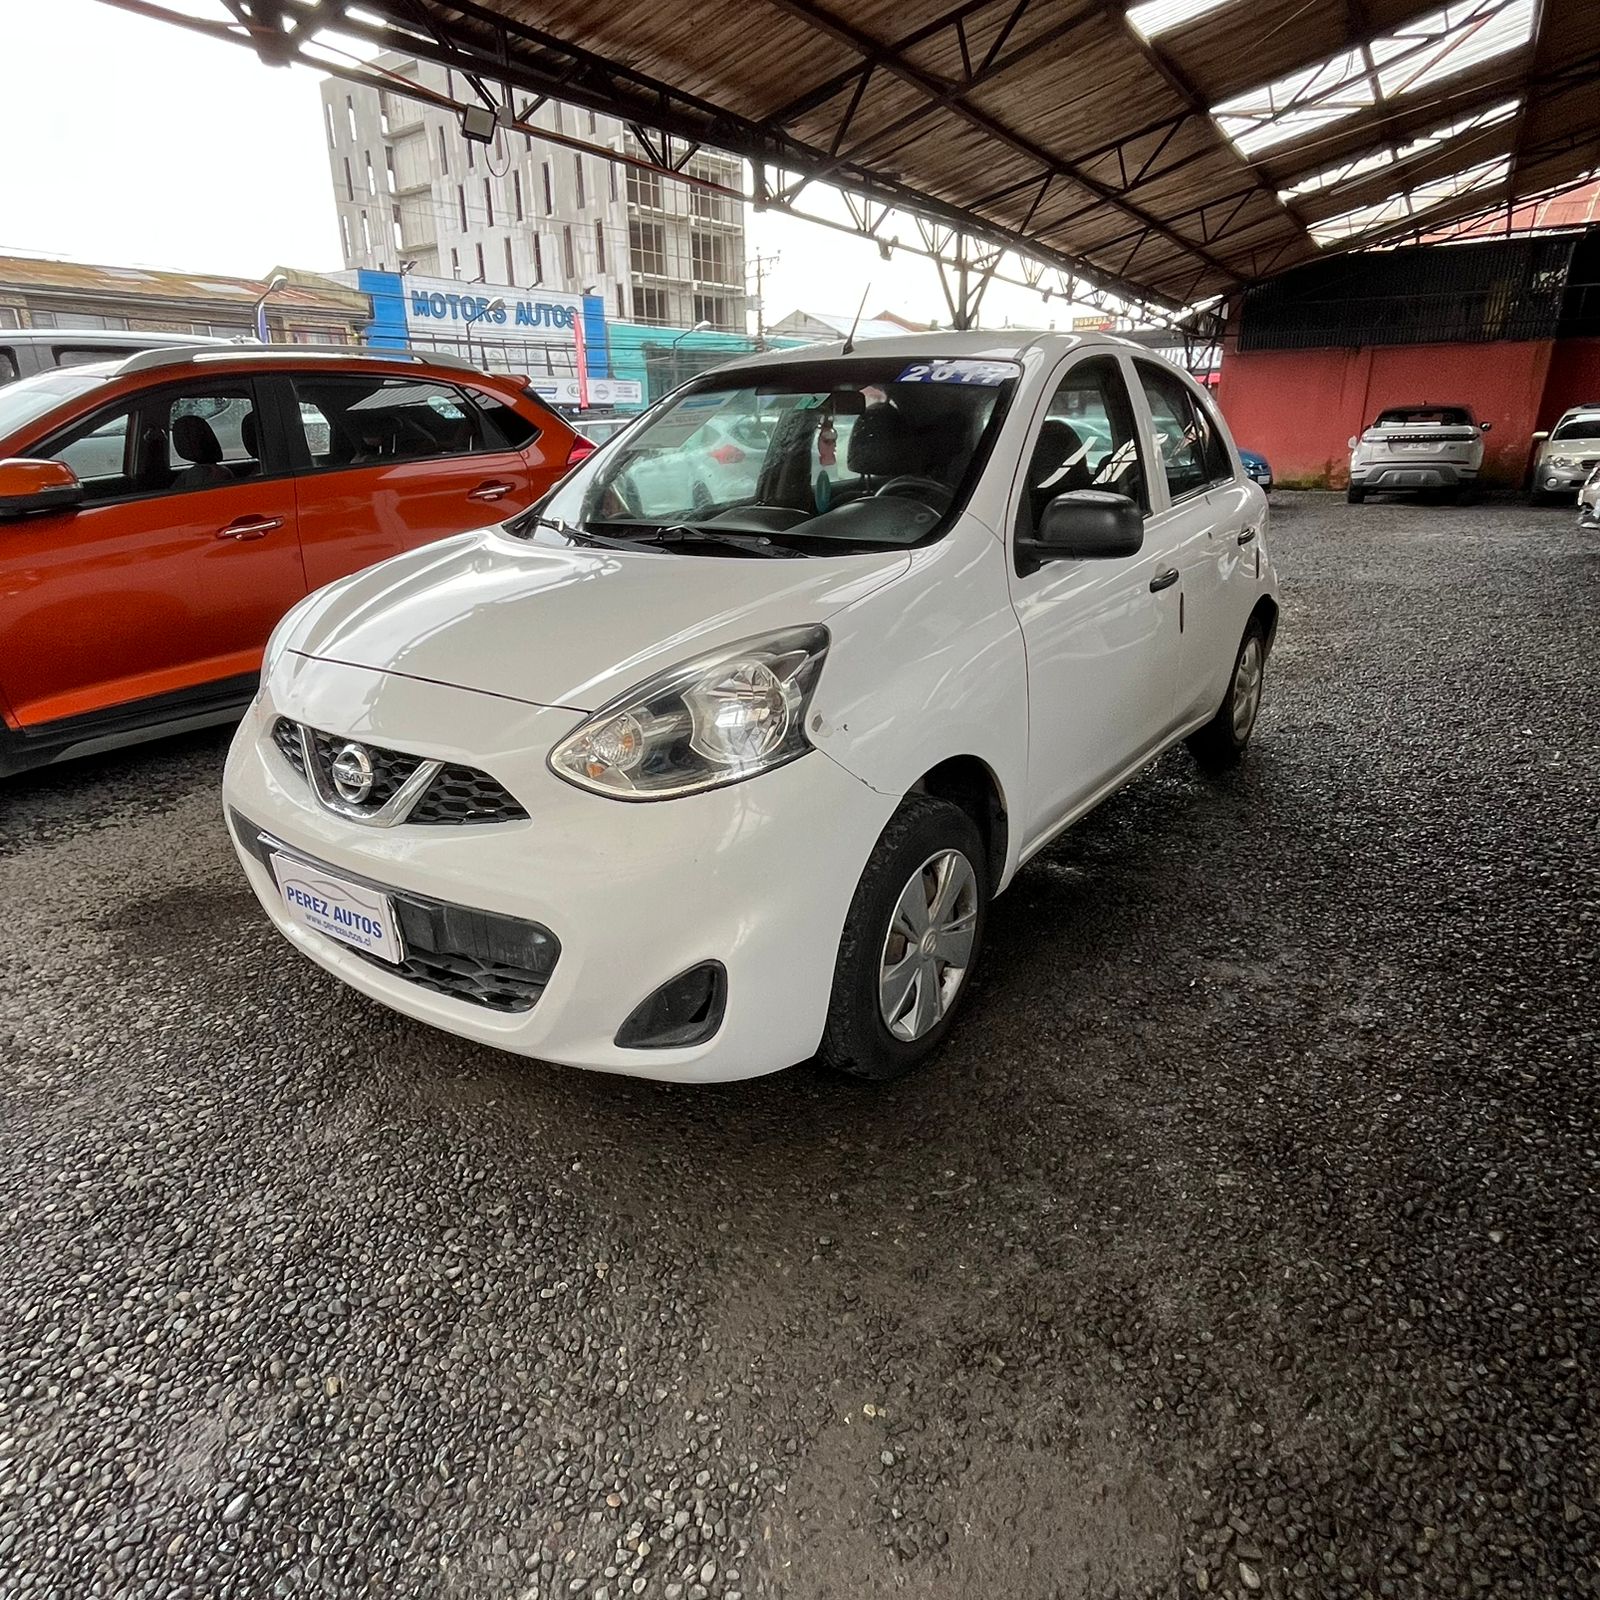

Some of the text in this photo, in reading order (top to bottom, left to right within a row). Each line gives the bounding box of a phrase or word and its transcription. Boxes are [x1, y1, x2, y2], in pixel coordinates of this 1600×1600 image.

[411, 290, 577, 329] MOTORS AUTOS
[286, 886, 382, 938] PEREZ AUTOS
